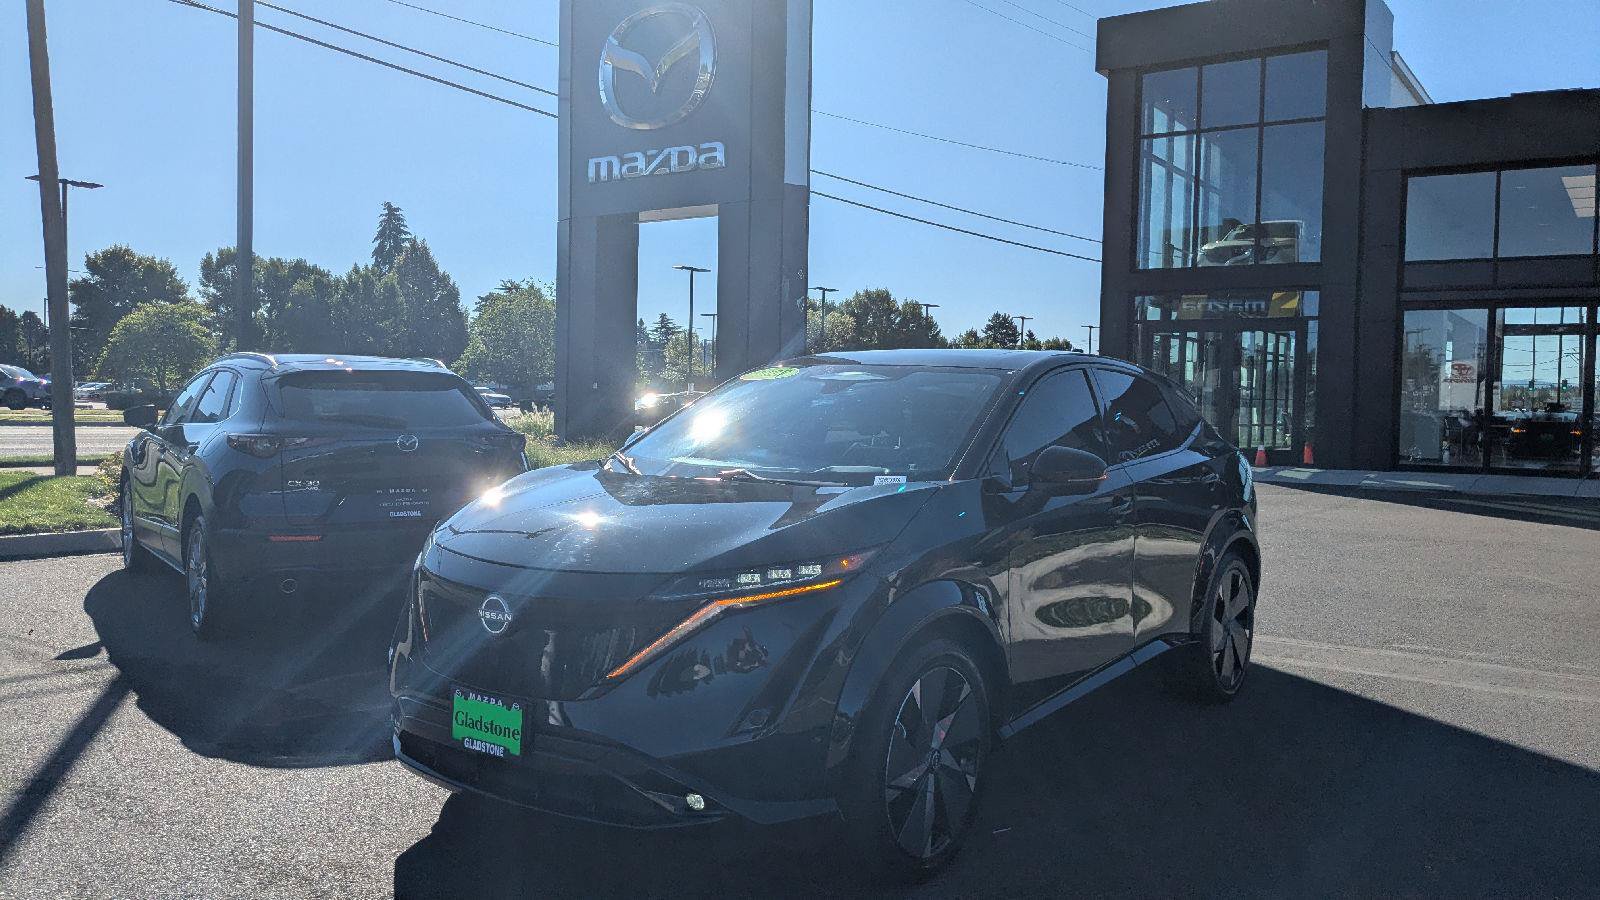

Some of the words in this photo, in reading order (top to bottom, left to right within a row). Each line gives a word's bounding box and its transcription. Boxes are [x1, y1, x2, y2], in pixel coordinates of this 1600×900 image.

[478, 609, 512, 621] NISSAN
[469, 692, 503, 707] MAZDA
[455, 711, 520, 741] Gladstone
[463, 737, 505, 757] GLADSTONE
